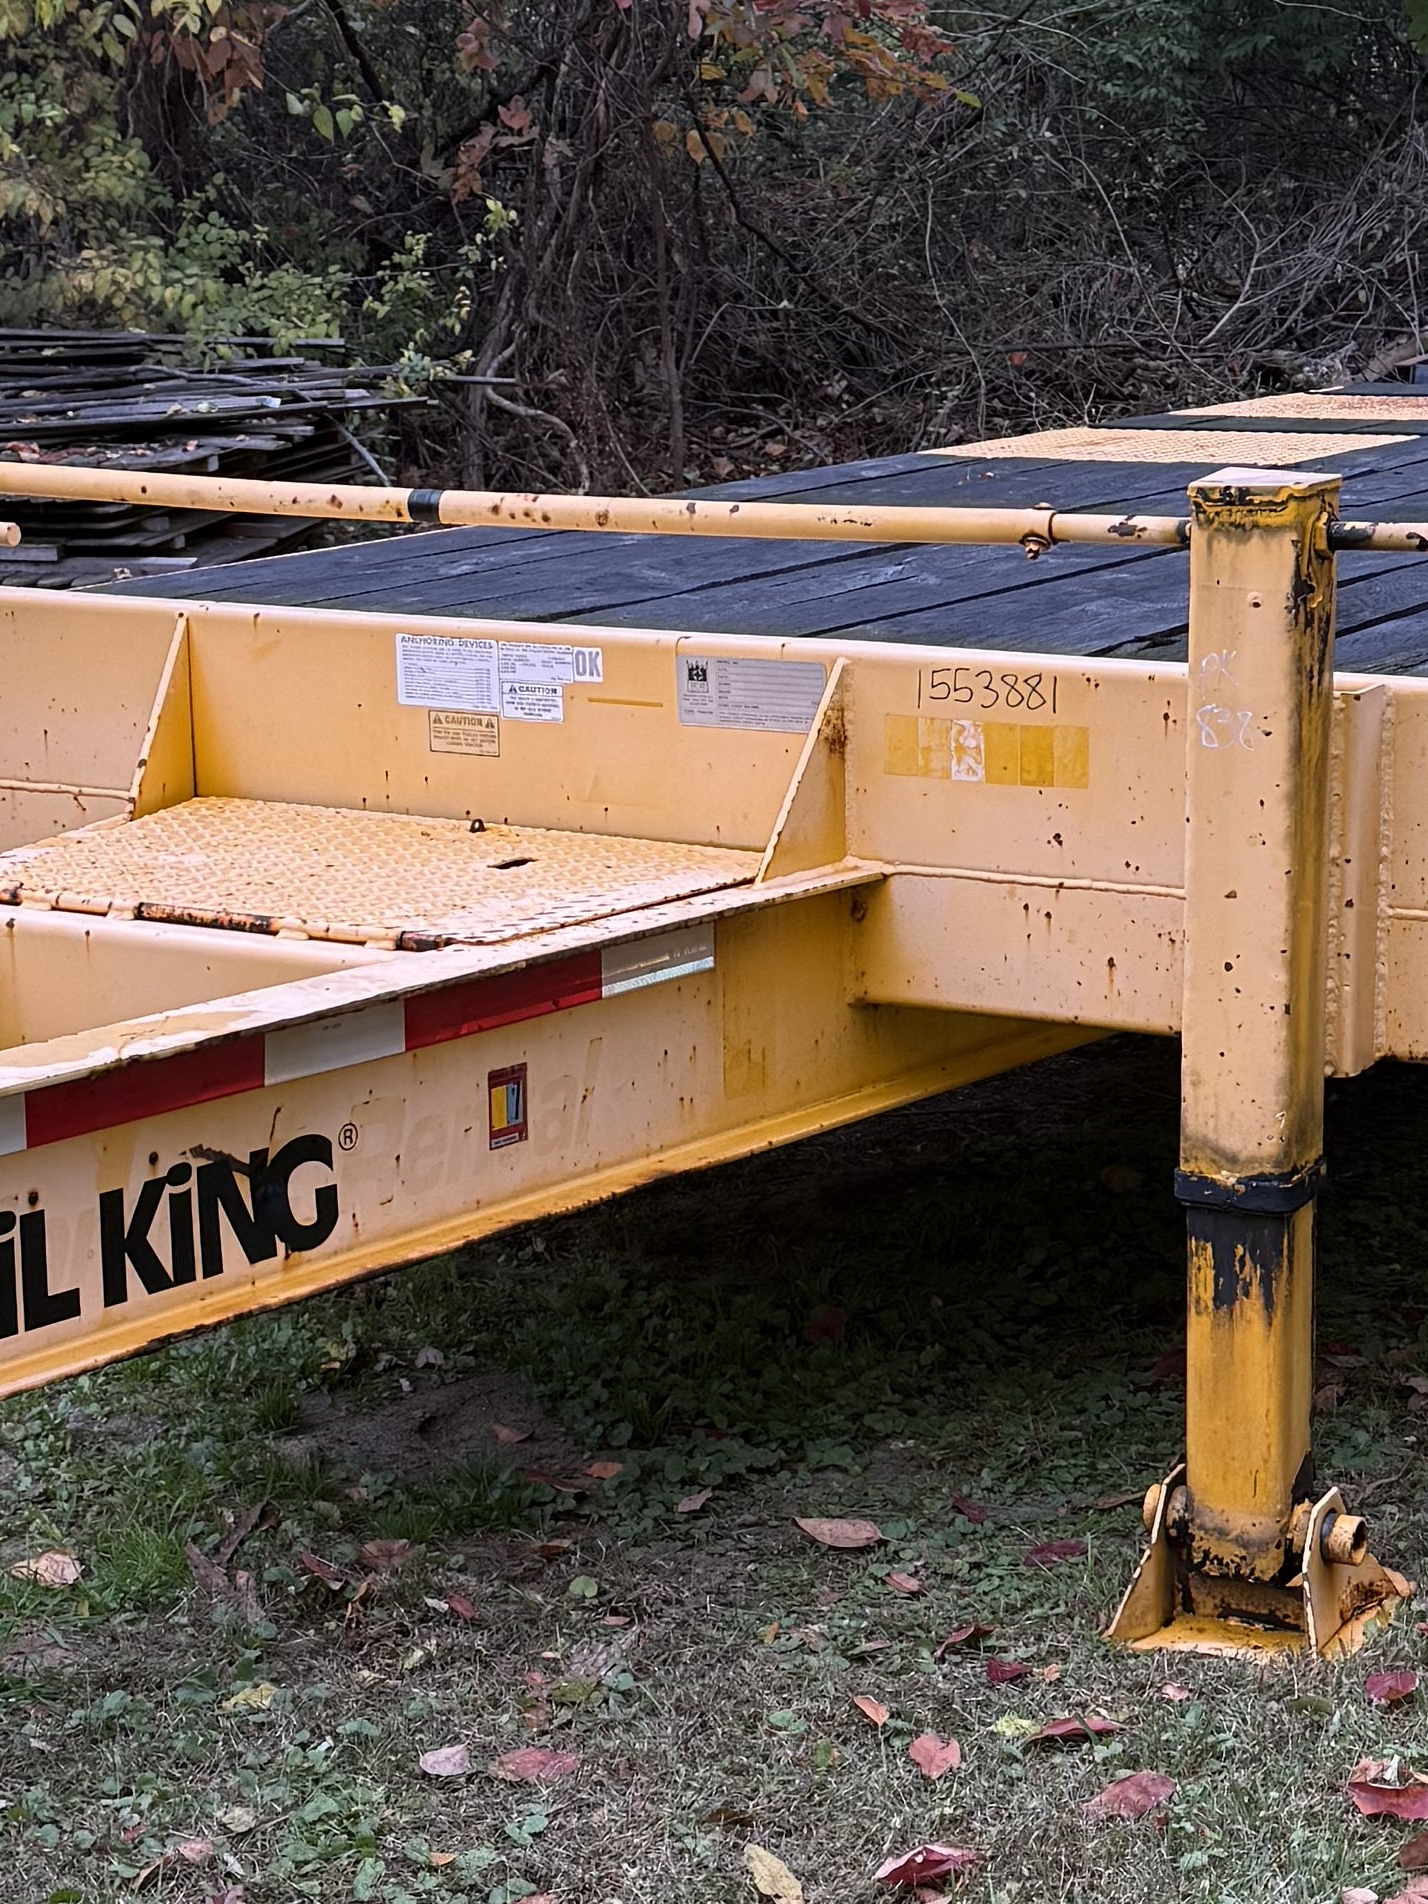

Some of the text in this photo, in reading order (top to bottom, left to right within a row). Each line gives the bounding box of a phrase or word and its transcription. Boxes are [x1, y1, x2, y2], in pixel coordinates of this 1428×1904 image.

[458, 640, 493, 649] DEVICES
[575, 650, 601, 677] OK
[518, 686, 558, 695] CAUTION
[917, 667, 1058, 714] 1553881
[444, 714, 483, 727] CAUTION
